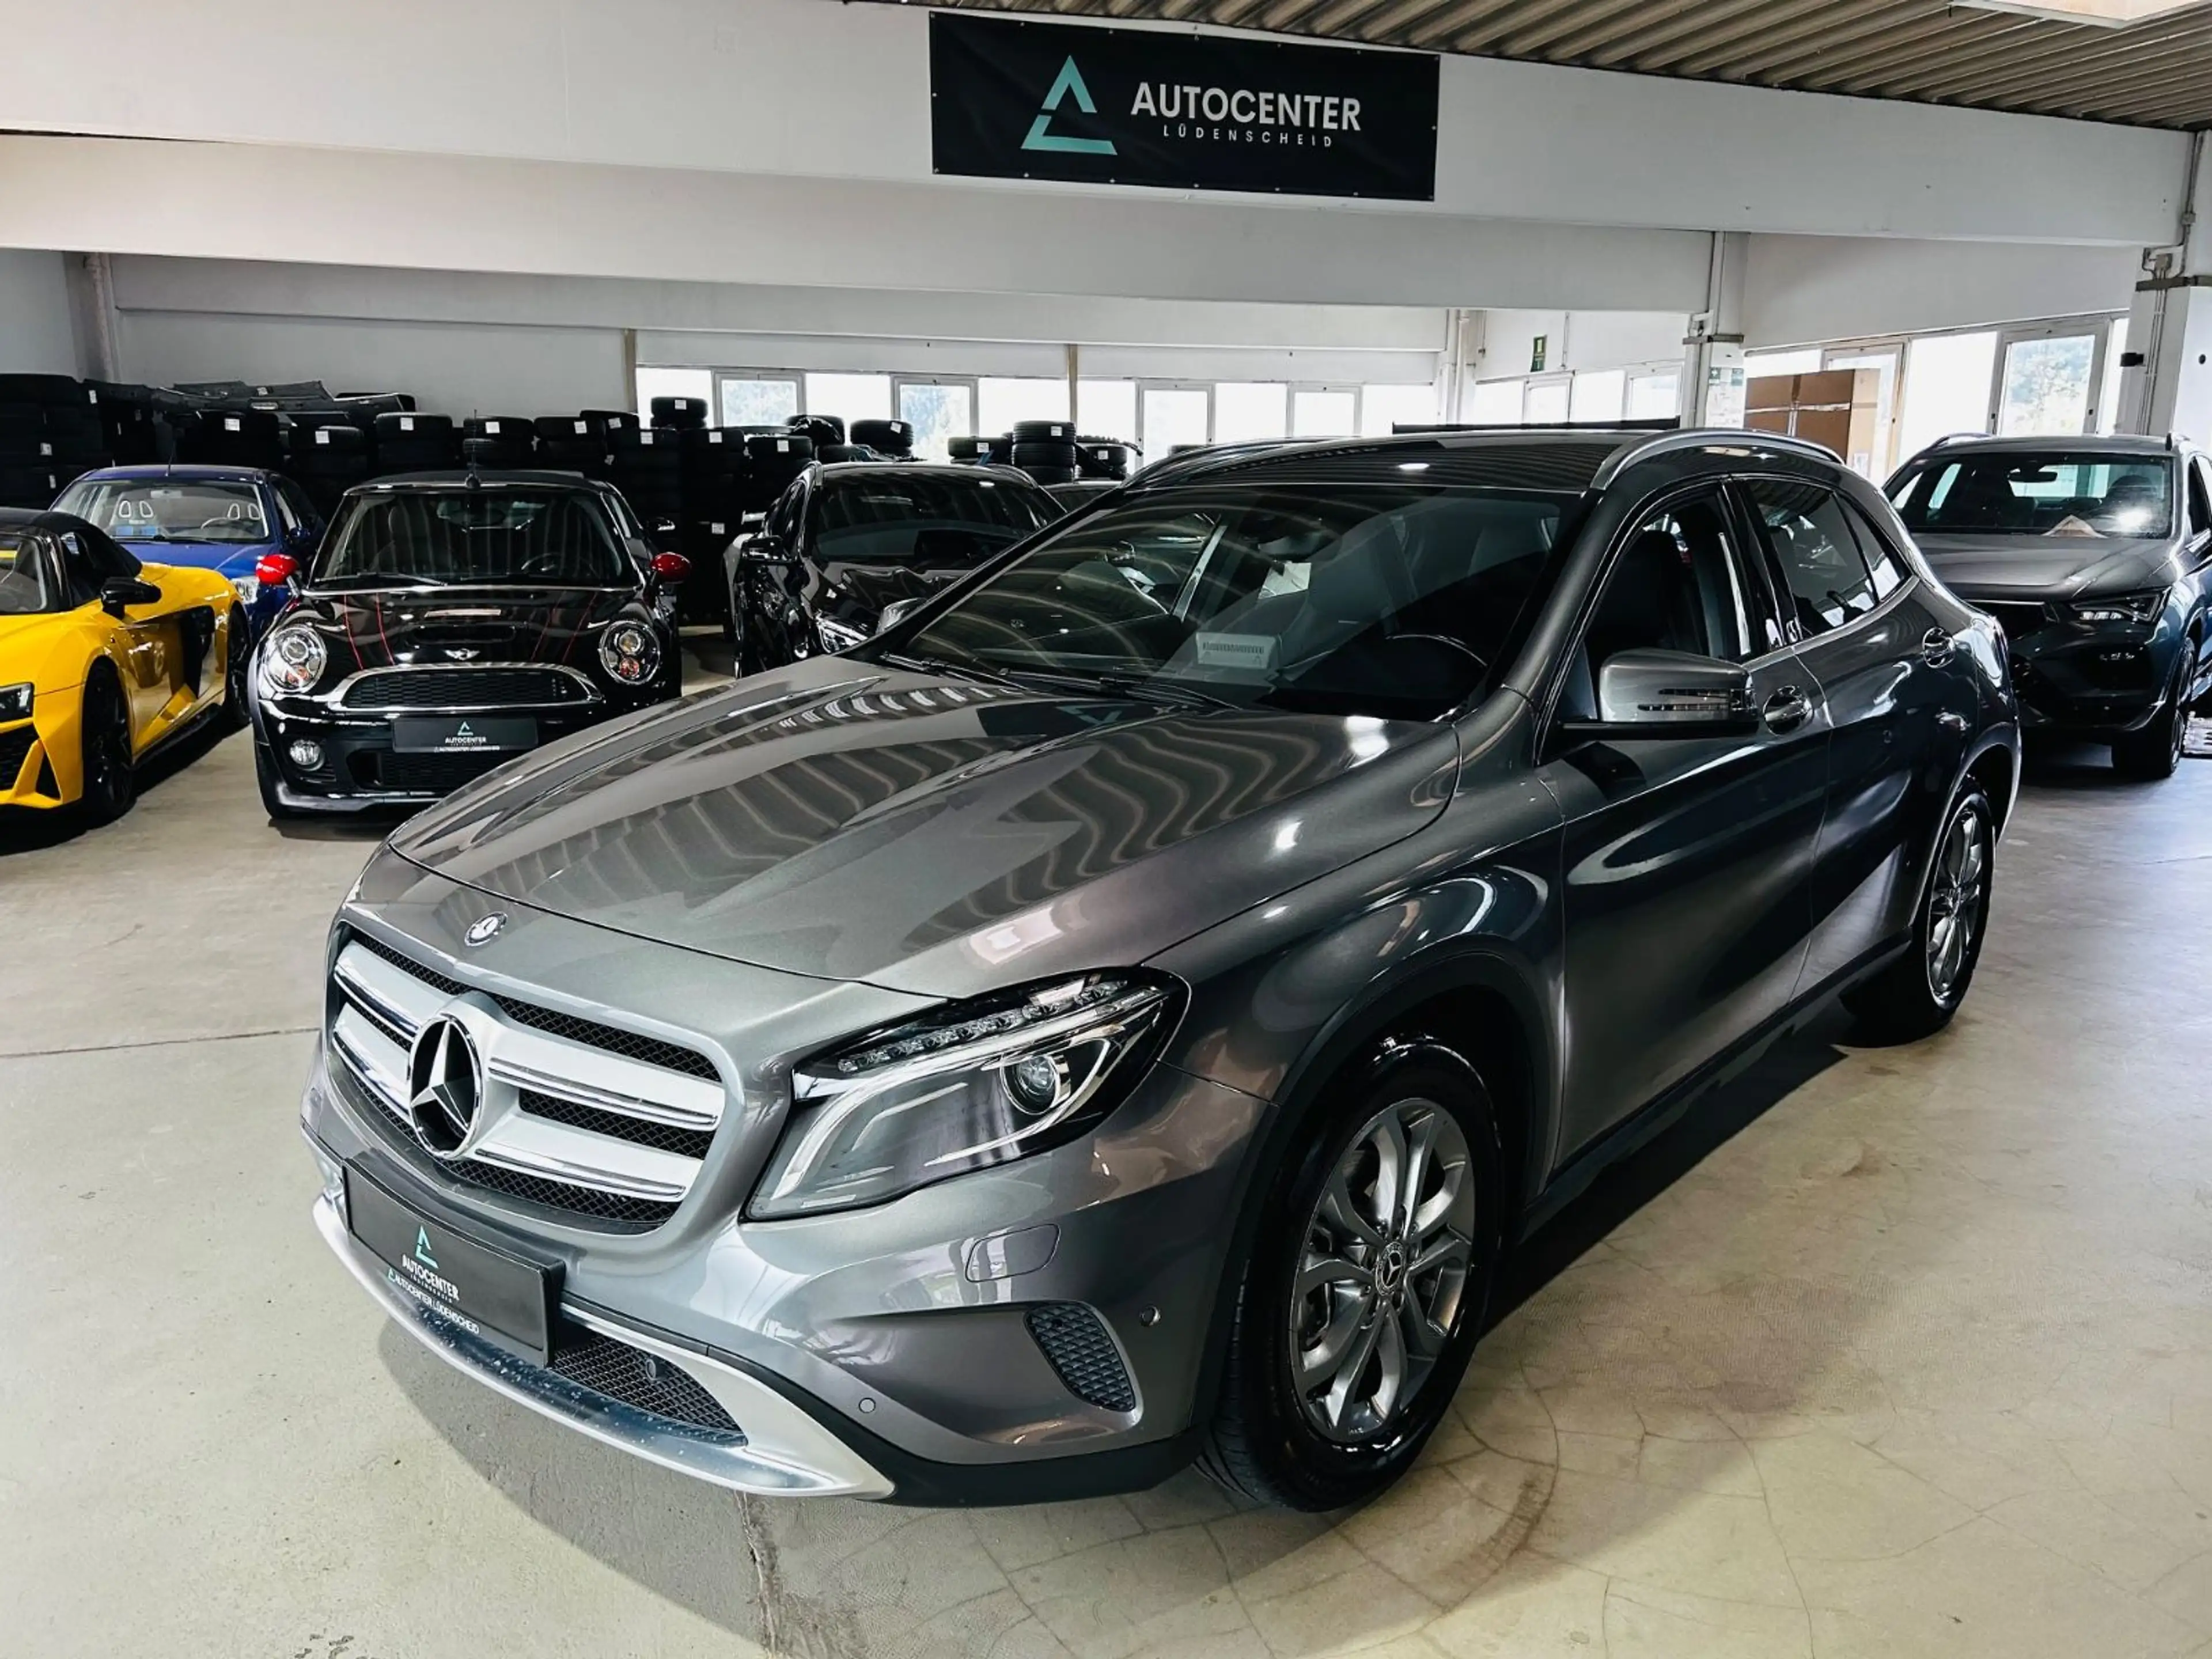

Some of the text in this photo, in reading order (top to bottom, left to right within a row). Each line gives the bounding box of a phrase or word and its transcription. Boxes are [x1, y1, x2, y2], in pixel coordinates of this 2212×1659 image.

[1130, 81, 1361, 131] AUTOCENTER
[1163, 123, 1332, 147] LÜDENSCHEID
[402, 1253, 460, 1301] AUTOCENTER
